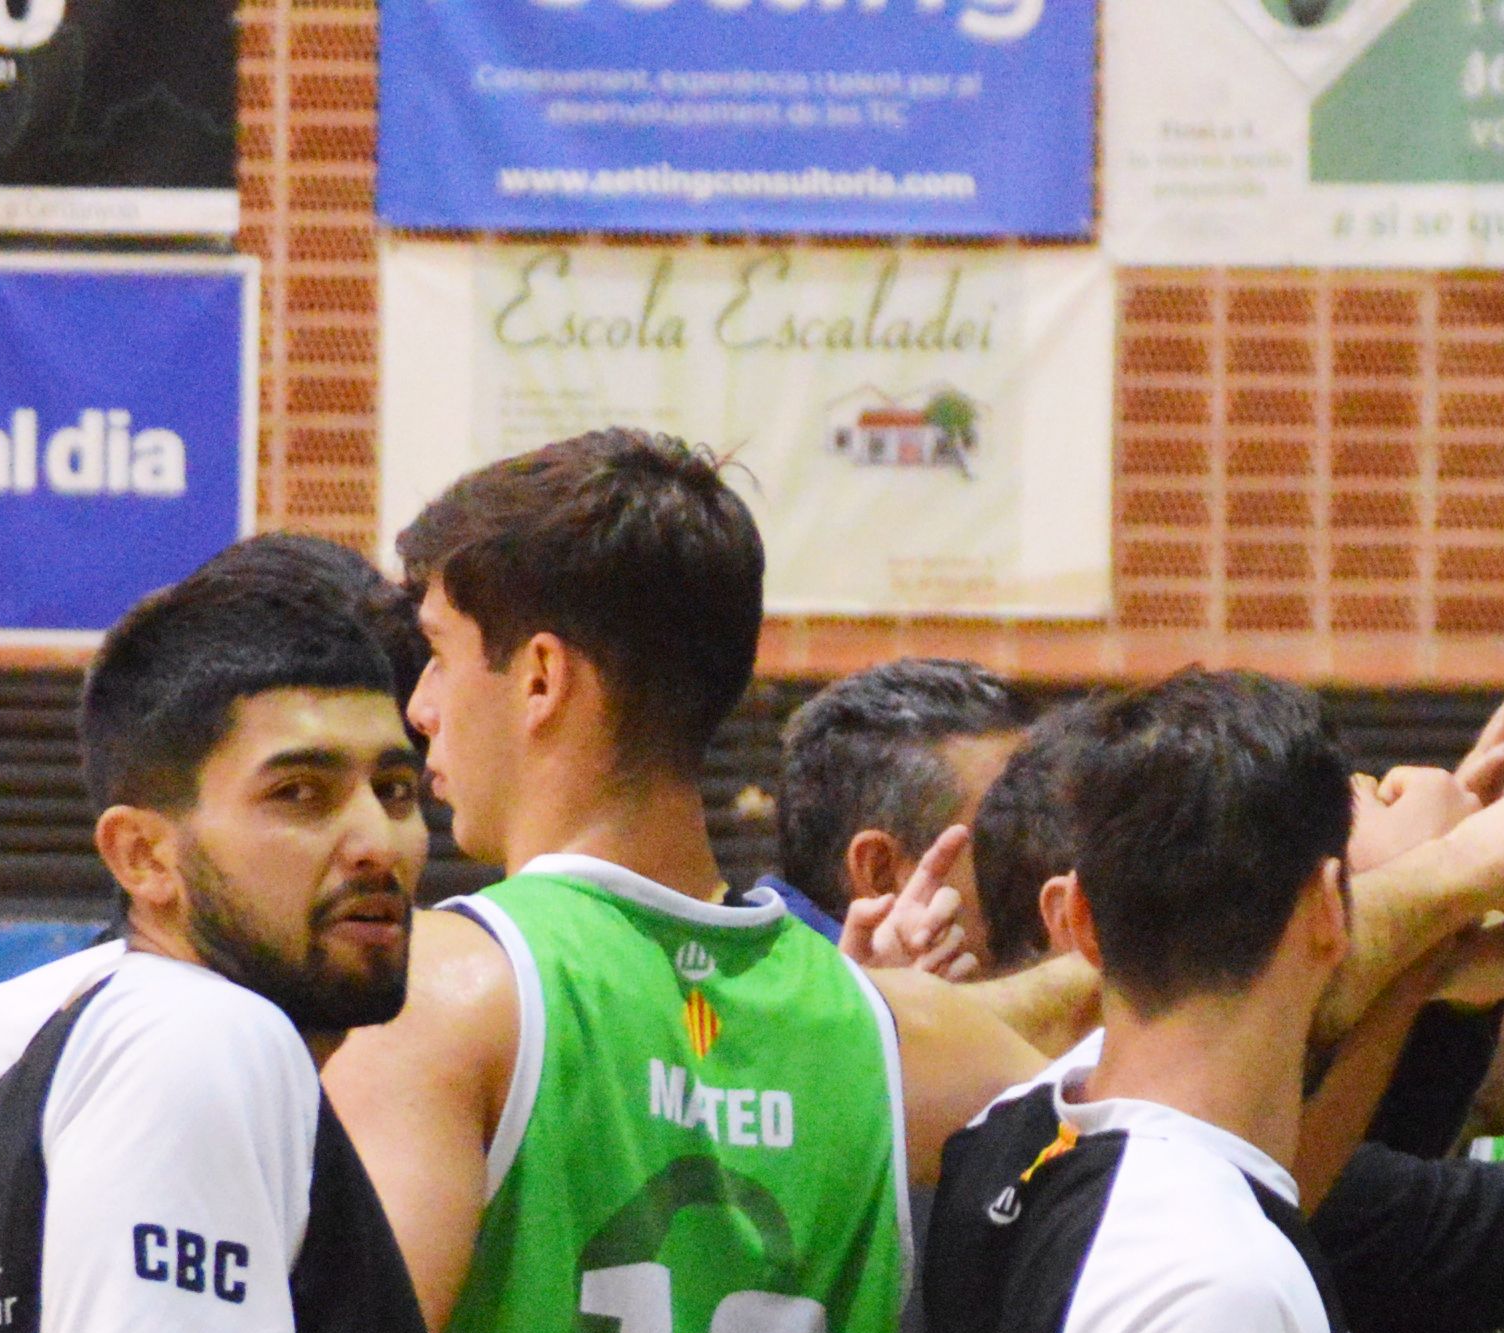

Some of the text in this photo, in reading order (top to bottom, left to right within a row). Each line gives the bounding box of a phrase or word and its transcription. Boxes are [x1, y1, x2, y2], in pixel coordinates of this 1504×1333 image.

[494, 250, 999, 354] Escola Escaladei
[46, 407, 186, 494] dia
[647, 1057, 794, 1149] MATEO
[133, 1223, 251, 1304] CBC
